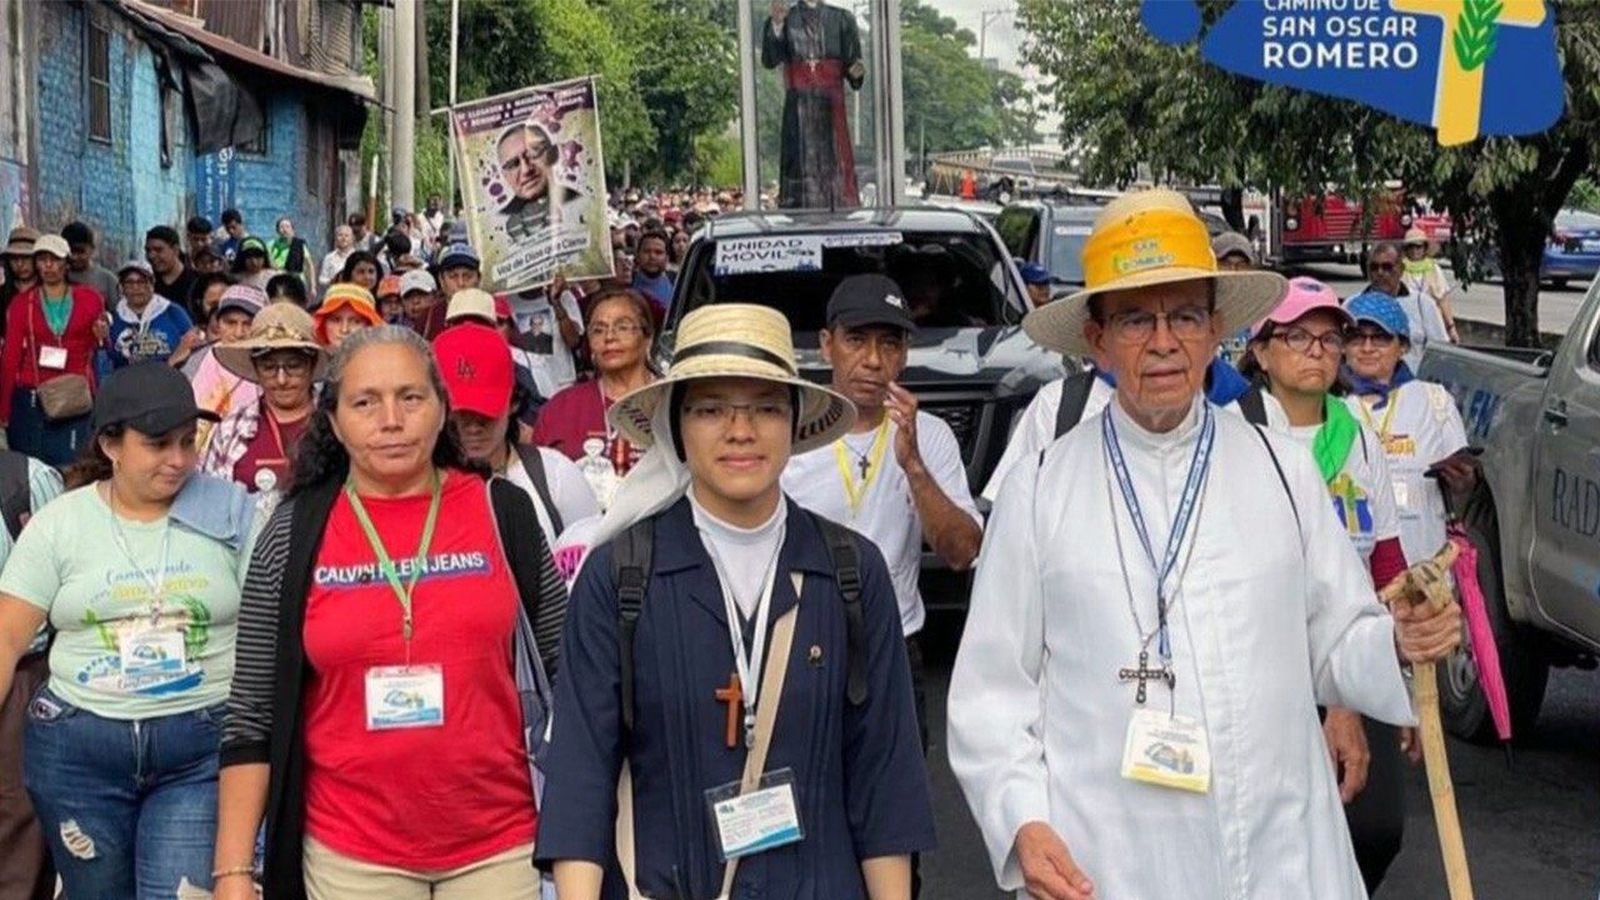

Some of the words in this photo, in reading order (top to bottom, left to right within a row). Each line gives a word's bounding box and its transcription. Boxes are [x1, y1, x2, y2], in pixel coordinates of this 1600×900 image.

[513, 257, 524, 269] de
[525, 248, 544, 263] Dios
[544, 242, 561, 255] qe
[721, 239, 804, 251] UNIDAD
[1552, 467, 1600, 538] RAD
[315, 563, 375, 583] CALVIN
[431, 552, 484, 572] JEANS
